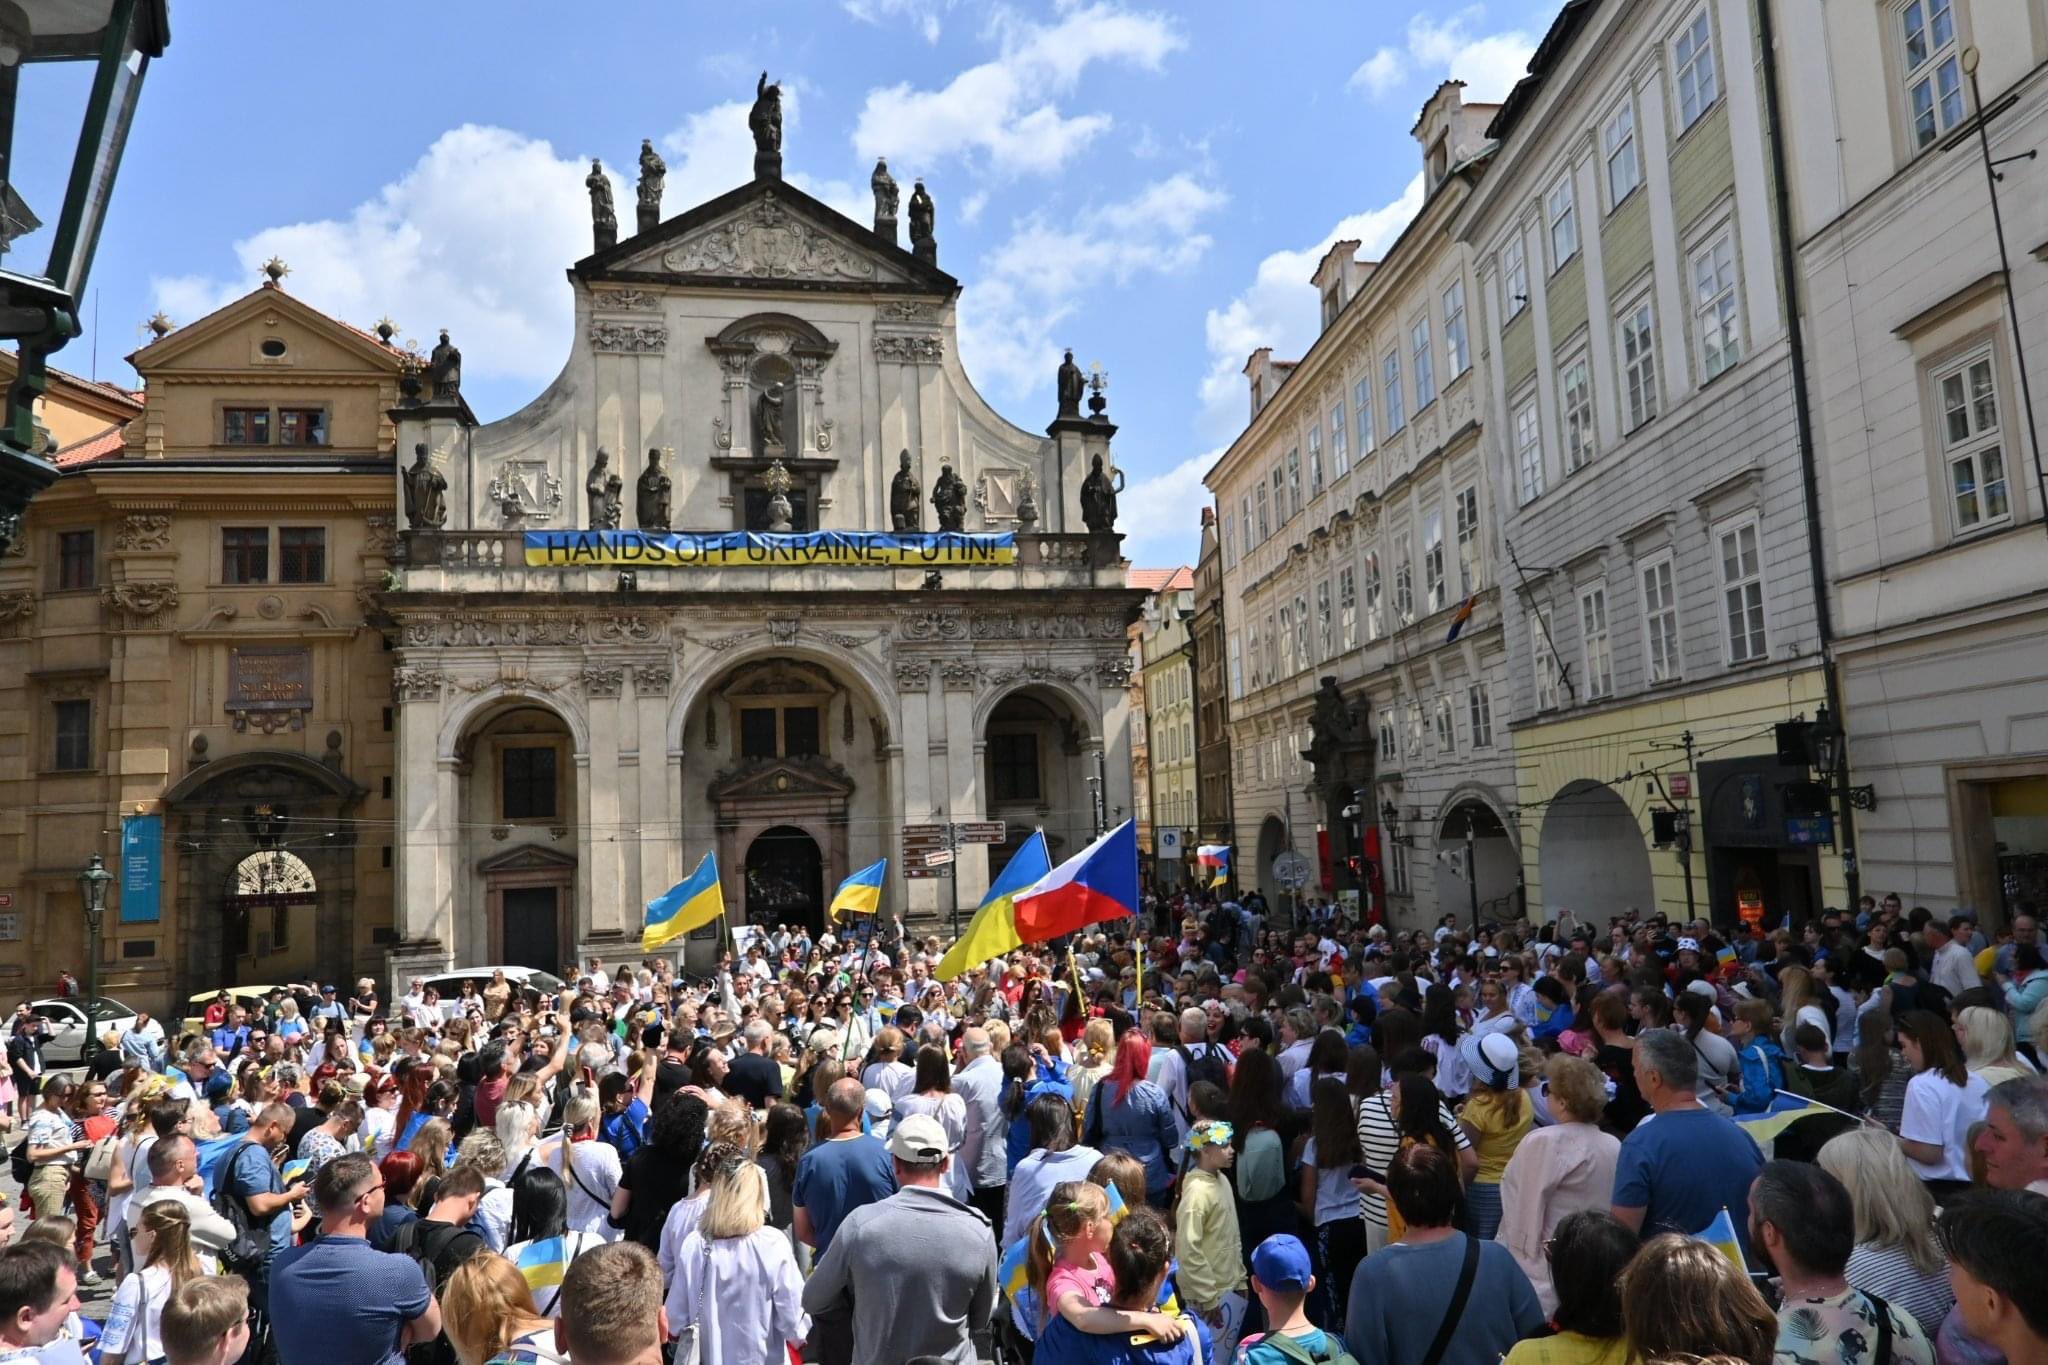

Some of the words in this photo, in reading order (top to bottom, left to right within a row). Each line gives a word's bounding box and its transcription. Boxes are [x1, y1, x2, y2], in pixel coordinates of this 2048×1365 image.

[546, 534, 666, 562] HANDS
[674, 534, 738, 562] OFF
[747, 534, 891, 563] UKRAINE,
[900, 533, 996, 561] PUTIN!
